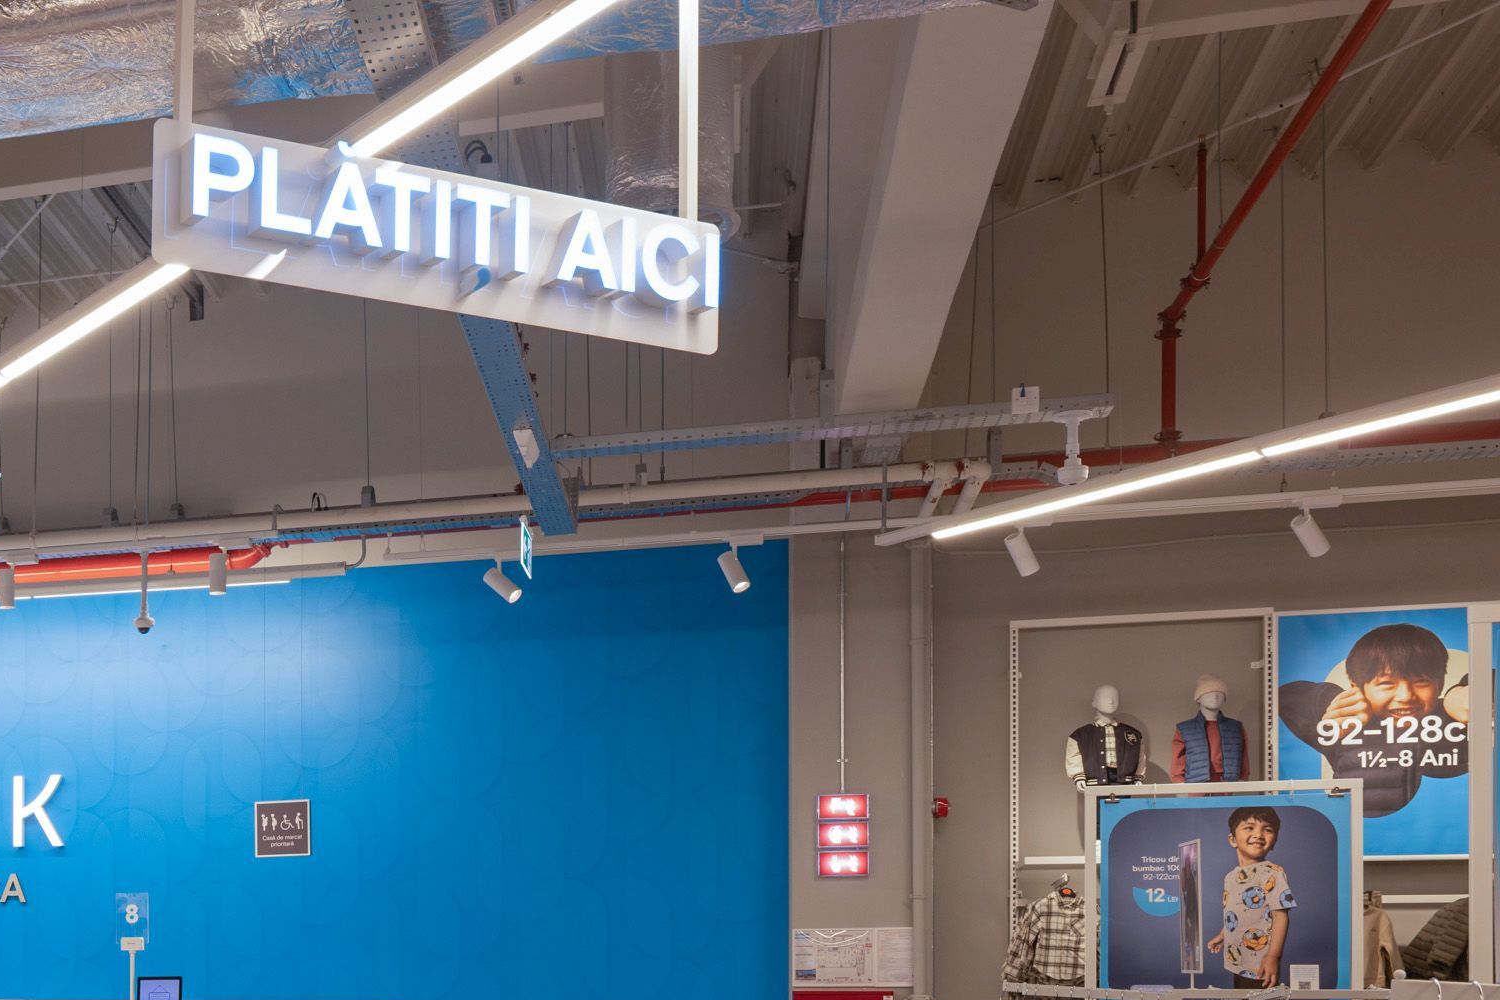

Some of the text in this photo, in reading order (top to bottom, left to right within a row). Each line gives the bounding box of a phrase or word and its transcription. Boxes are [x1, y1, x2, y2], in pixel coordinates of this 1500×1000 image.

[556, 207, 721, 308] AICI
[1316, 715, 1468, 746] 92-128c
[1420, 748, 1459, 767] Ani
[1145, 887, 1166, 903] 12
[125, 903, 139, 924] 8
